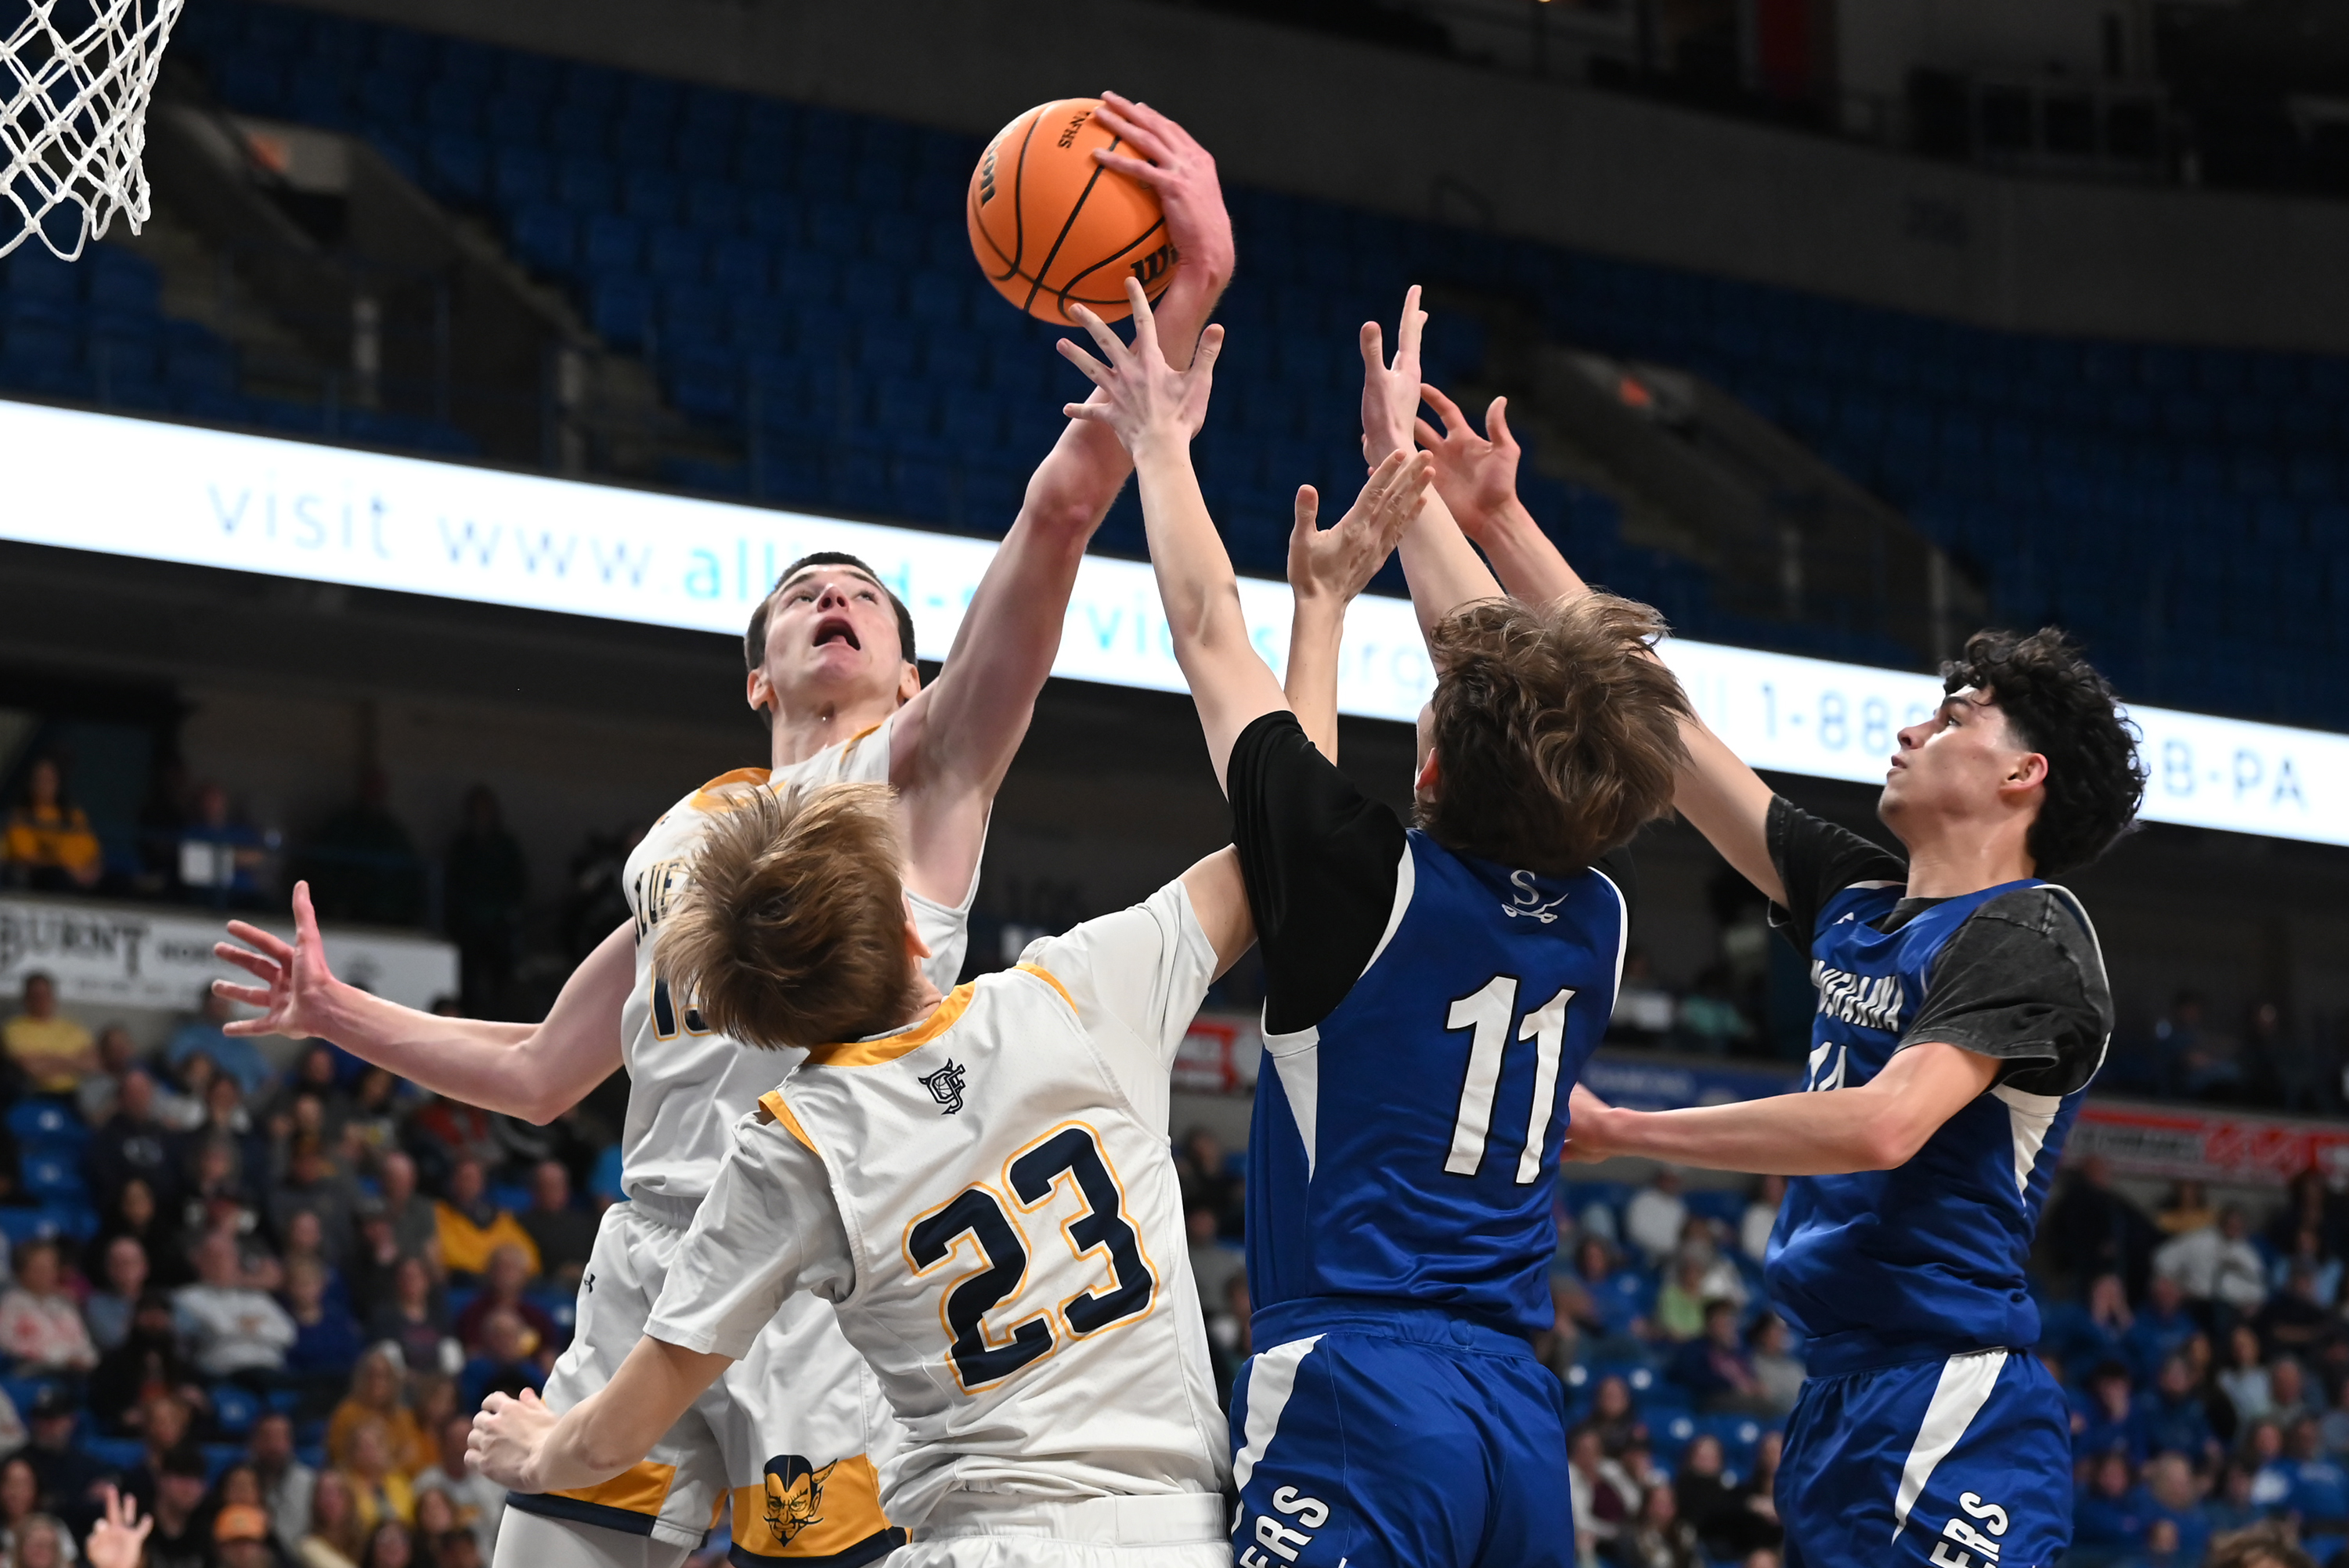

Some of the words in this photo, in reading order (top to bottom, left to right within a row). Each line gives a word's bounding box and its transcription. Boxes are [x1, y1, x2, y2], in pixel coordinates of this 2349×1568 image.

[205, 467, 395, 561] visit
[1444, 975, 1576, 1185] 11
[902, 1120, 1160, 1396] 23
